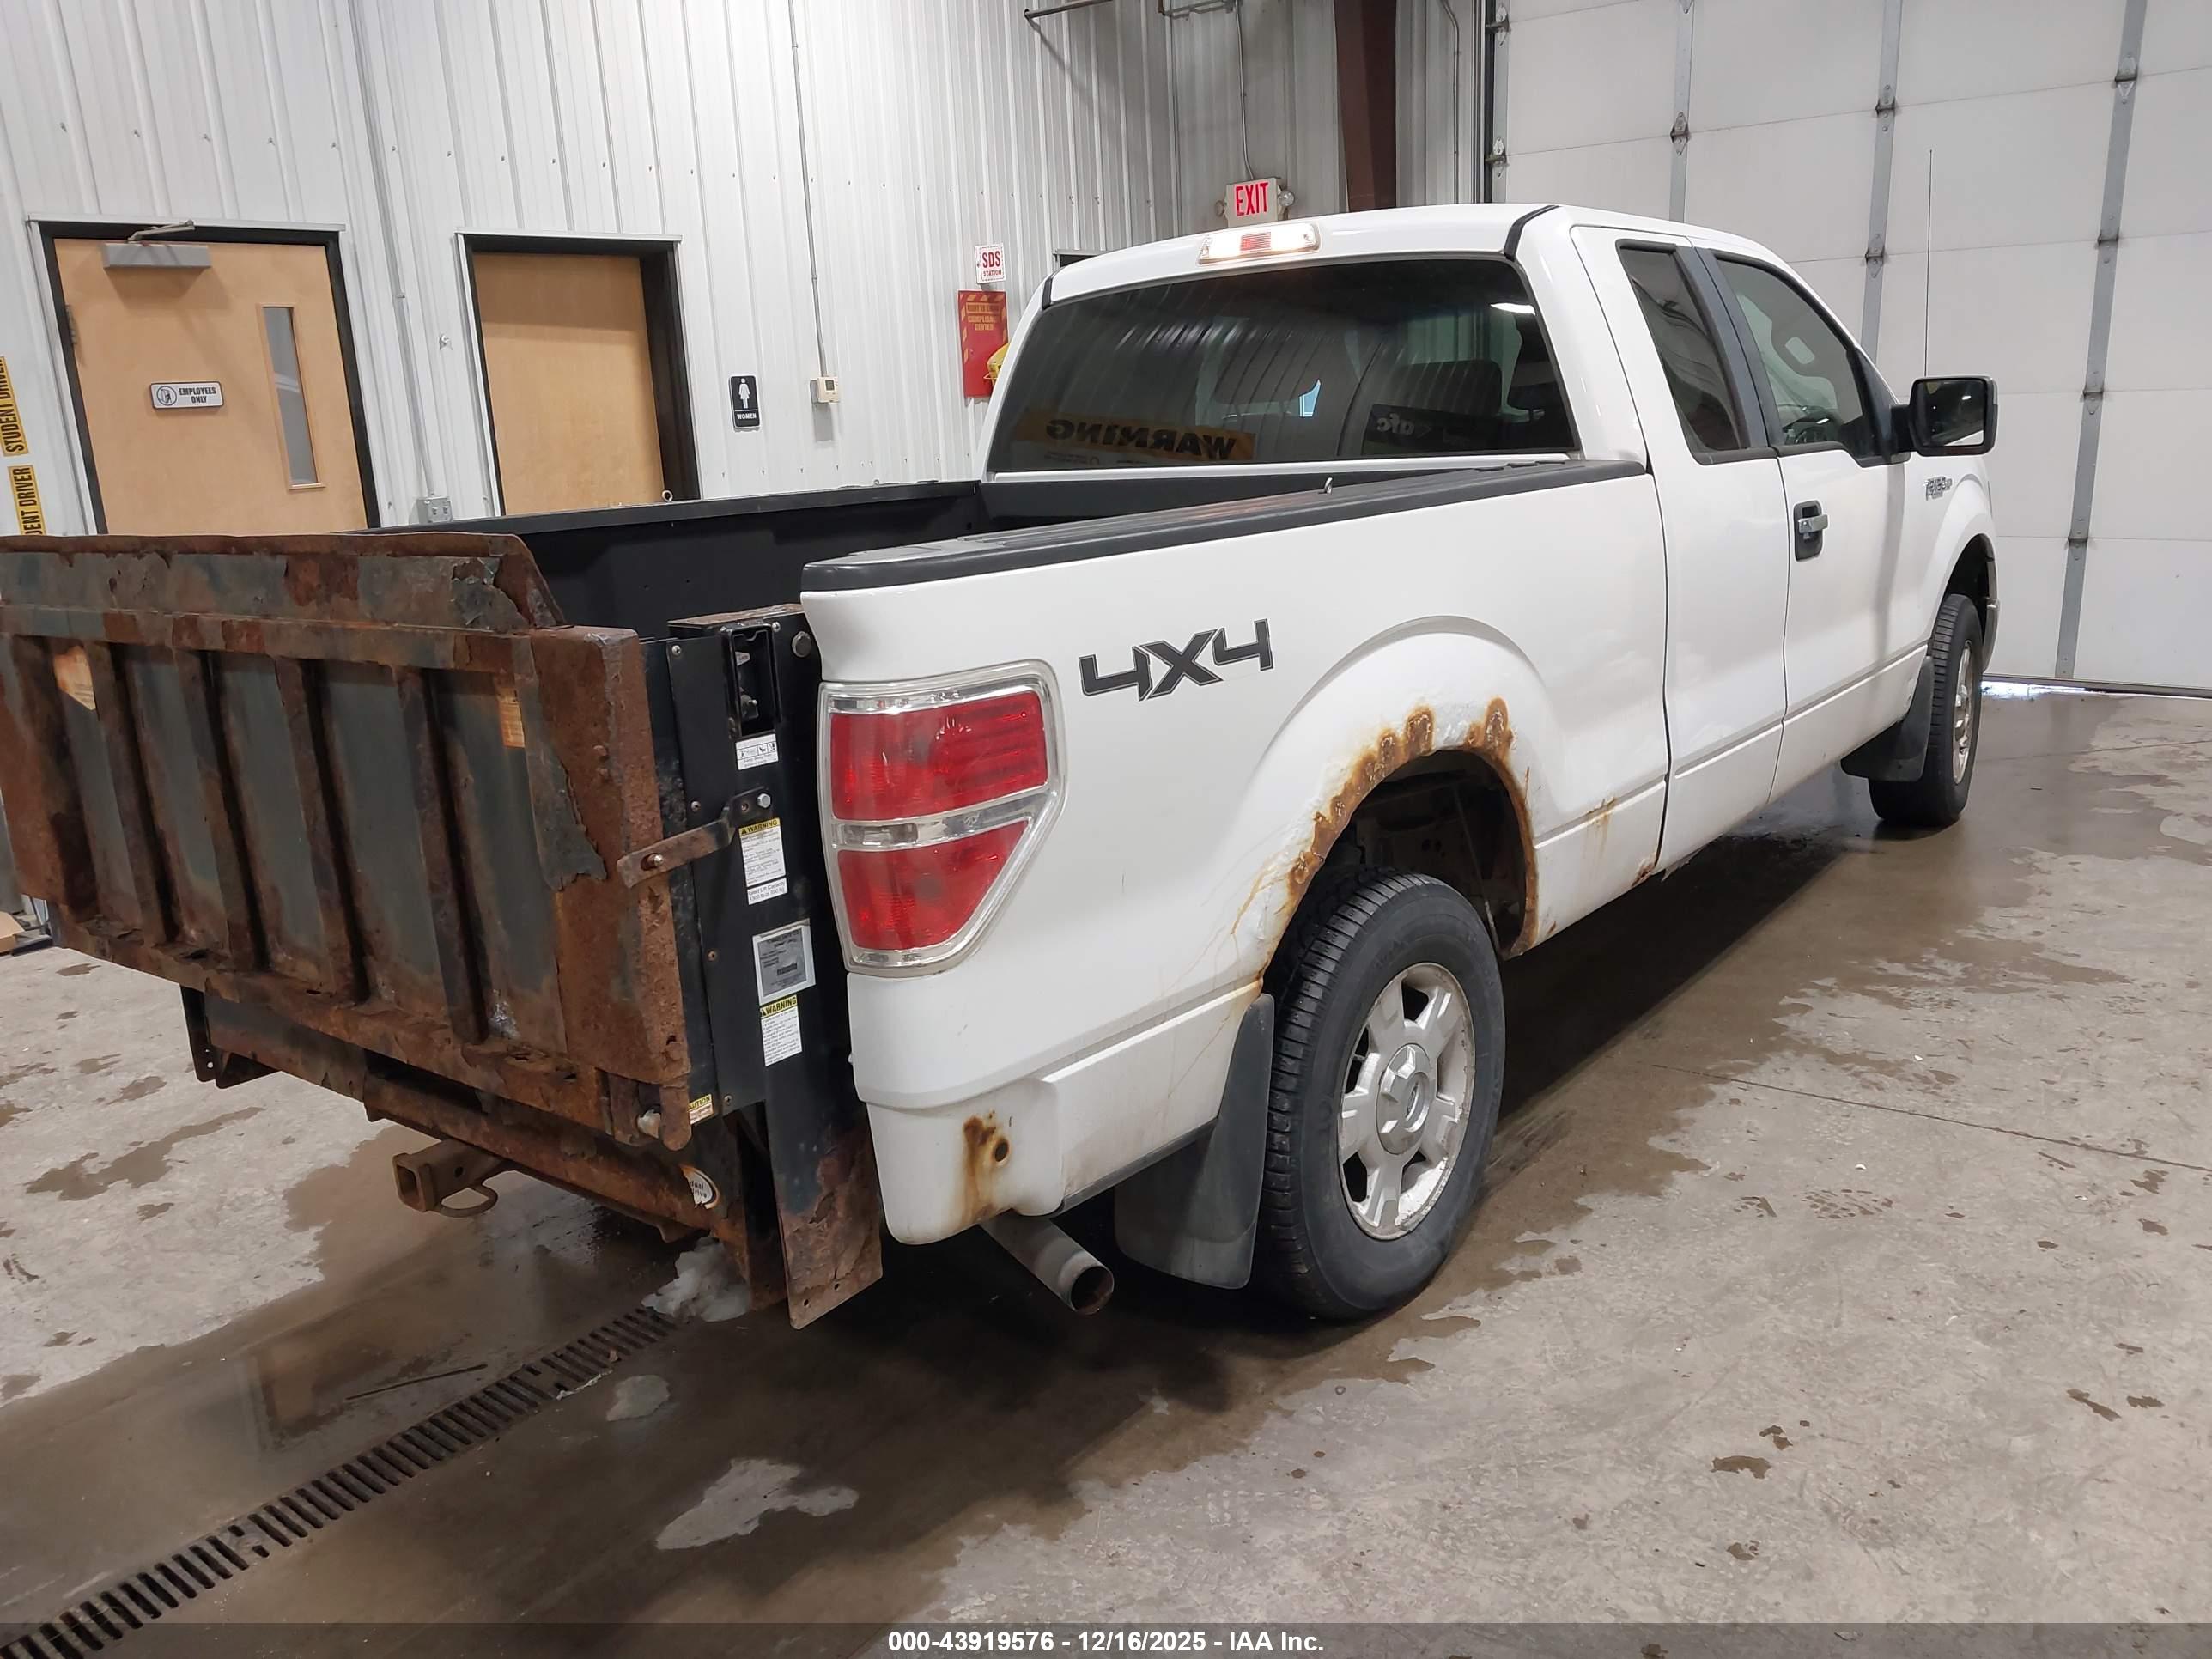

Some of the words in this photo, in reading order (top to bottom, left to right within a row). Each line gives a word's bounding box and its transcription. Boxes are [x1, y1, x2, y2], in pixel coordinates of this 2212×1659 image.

[1236, 182, 1269, 216] EXIT
[981, 251, 1001, 268] SDS
[179, 386, 216, 396] EMPLOYEES
[0, 404, 25, 453] STUDENT
[12, 467, 38, 507] DRIVER
[20, 510, 43, 536] DENT
[1079, 618, 1273, 702] 4X4
[747, 819, 778, 834] WARNING
[765, 996, 797, 1014] WARNING
[689, 1096, 710, 1109] AUTION
